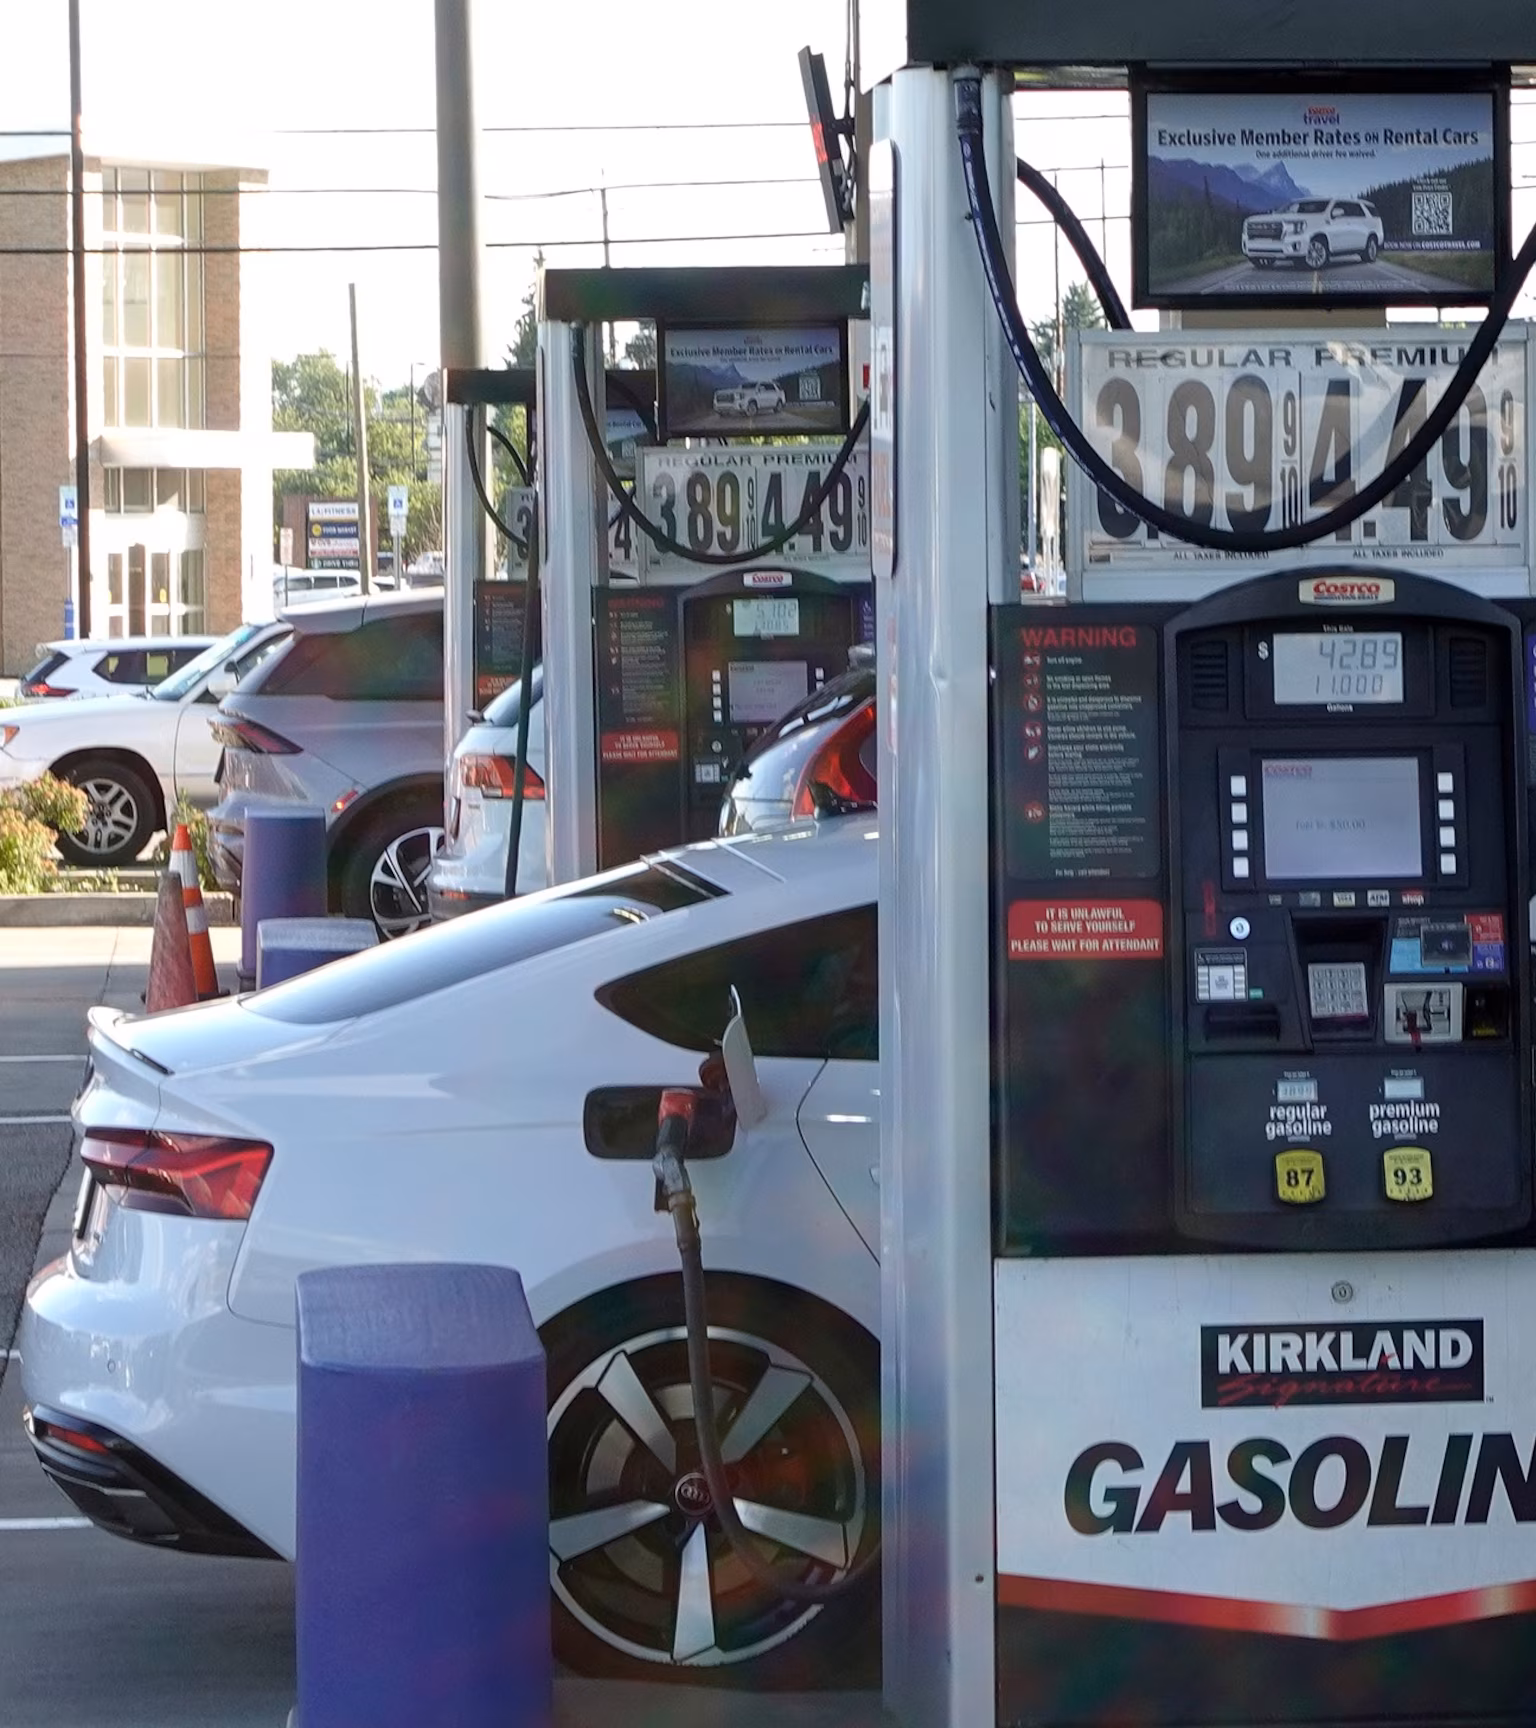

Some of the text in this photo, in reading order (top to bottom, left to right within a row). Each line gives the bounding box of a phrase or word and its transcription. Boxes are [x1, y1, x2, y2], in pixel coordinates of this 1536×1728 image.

[1303, 113, 1340, 125] travel
[1158, 128, 1478, 146] Exclusive Member Rates ON Rental Cars
[1272, 150, 1310, 159] additional
[671, 347, 710, 357] Exclusive
[712, 346, 746, 356] Member
[749, 346, 773, 356] Rates
[784, 346, 812, 356] Rental
[814, 345, 833, 355] Cars
[1108, 348, 1292, 368] REGULAR
[658, 455, 752, 467] REGULAR
[653, 471, 740, 553] 389
[1313, 581, 1380, 593] COSTCO
[1022, 627, 1137, 647] WARNING
[1258, 641, 1269, 660] $
[1318, 639, 1399, 670] 42.89
[1315, 674, 1384, 695] 11.000
[1046, 907, 1124, 920] IT IS UNLAWFUL
[1035, 920, 1135, 933] TO SERVE YOURSELF
[1011, 938, 1160, 952] PLEASE WAIT FOR ATTENDANT
[1270, 1102, 1327, 1122] regular
[1369, 1100, 1440, 1121] premium
[1265, 1116, 1332, 1140] gasoline
[1372, 1114, 1439, 1138] gasoline
[1286, 1168, 1315, 1188] 87
[1393, 1168, 1423, 1186] 93
[1218, 1329, 1473, 1374] KIRKLAND
[1217, 1373, 1472, 1408] Signature
